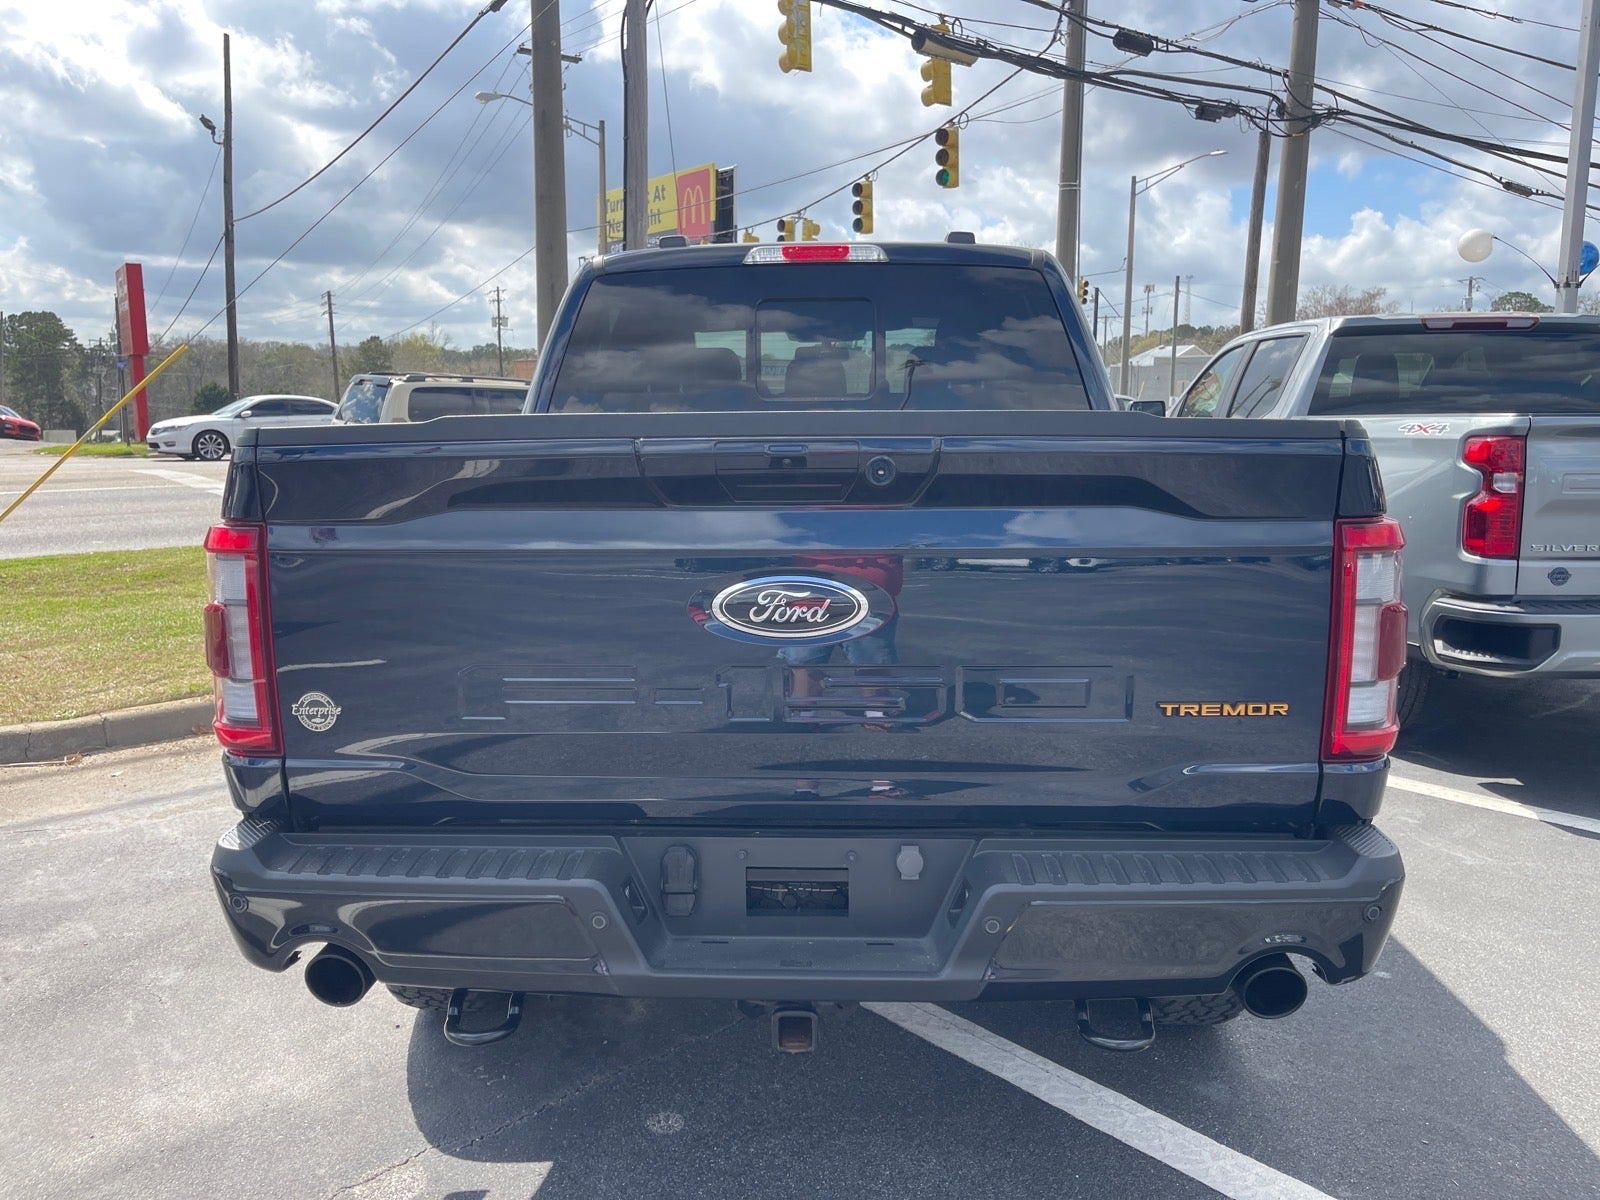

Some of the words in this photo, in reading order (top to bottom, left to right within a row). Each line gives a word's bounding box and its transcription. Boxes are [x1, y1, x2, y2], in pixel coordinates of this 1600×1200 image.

[654, 185, 665, 202] At
[749, 589, 831, 622] Ford
[458, 664, 1133, 723] F-150
[292, 704, 342, 717] Enterprise
[1157, 702, 1289, 716] TREMOR
